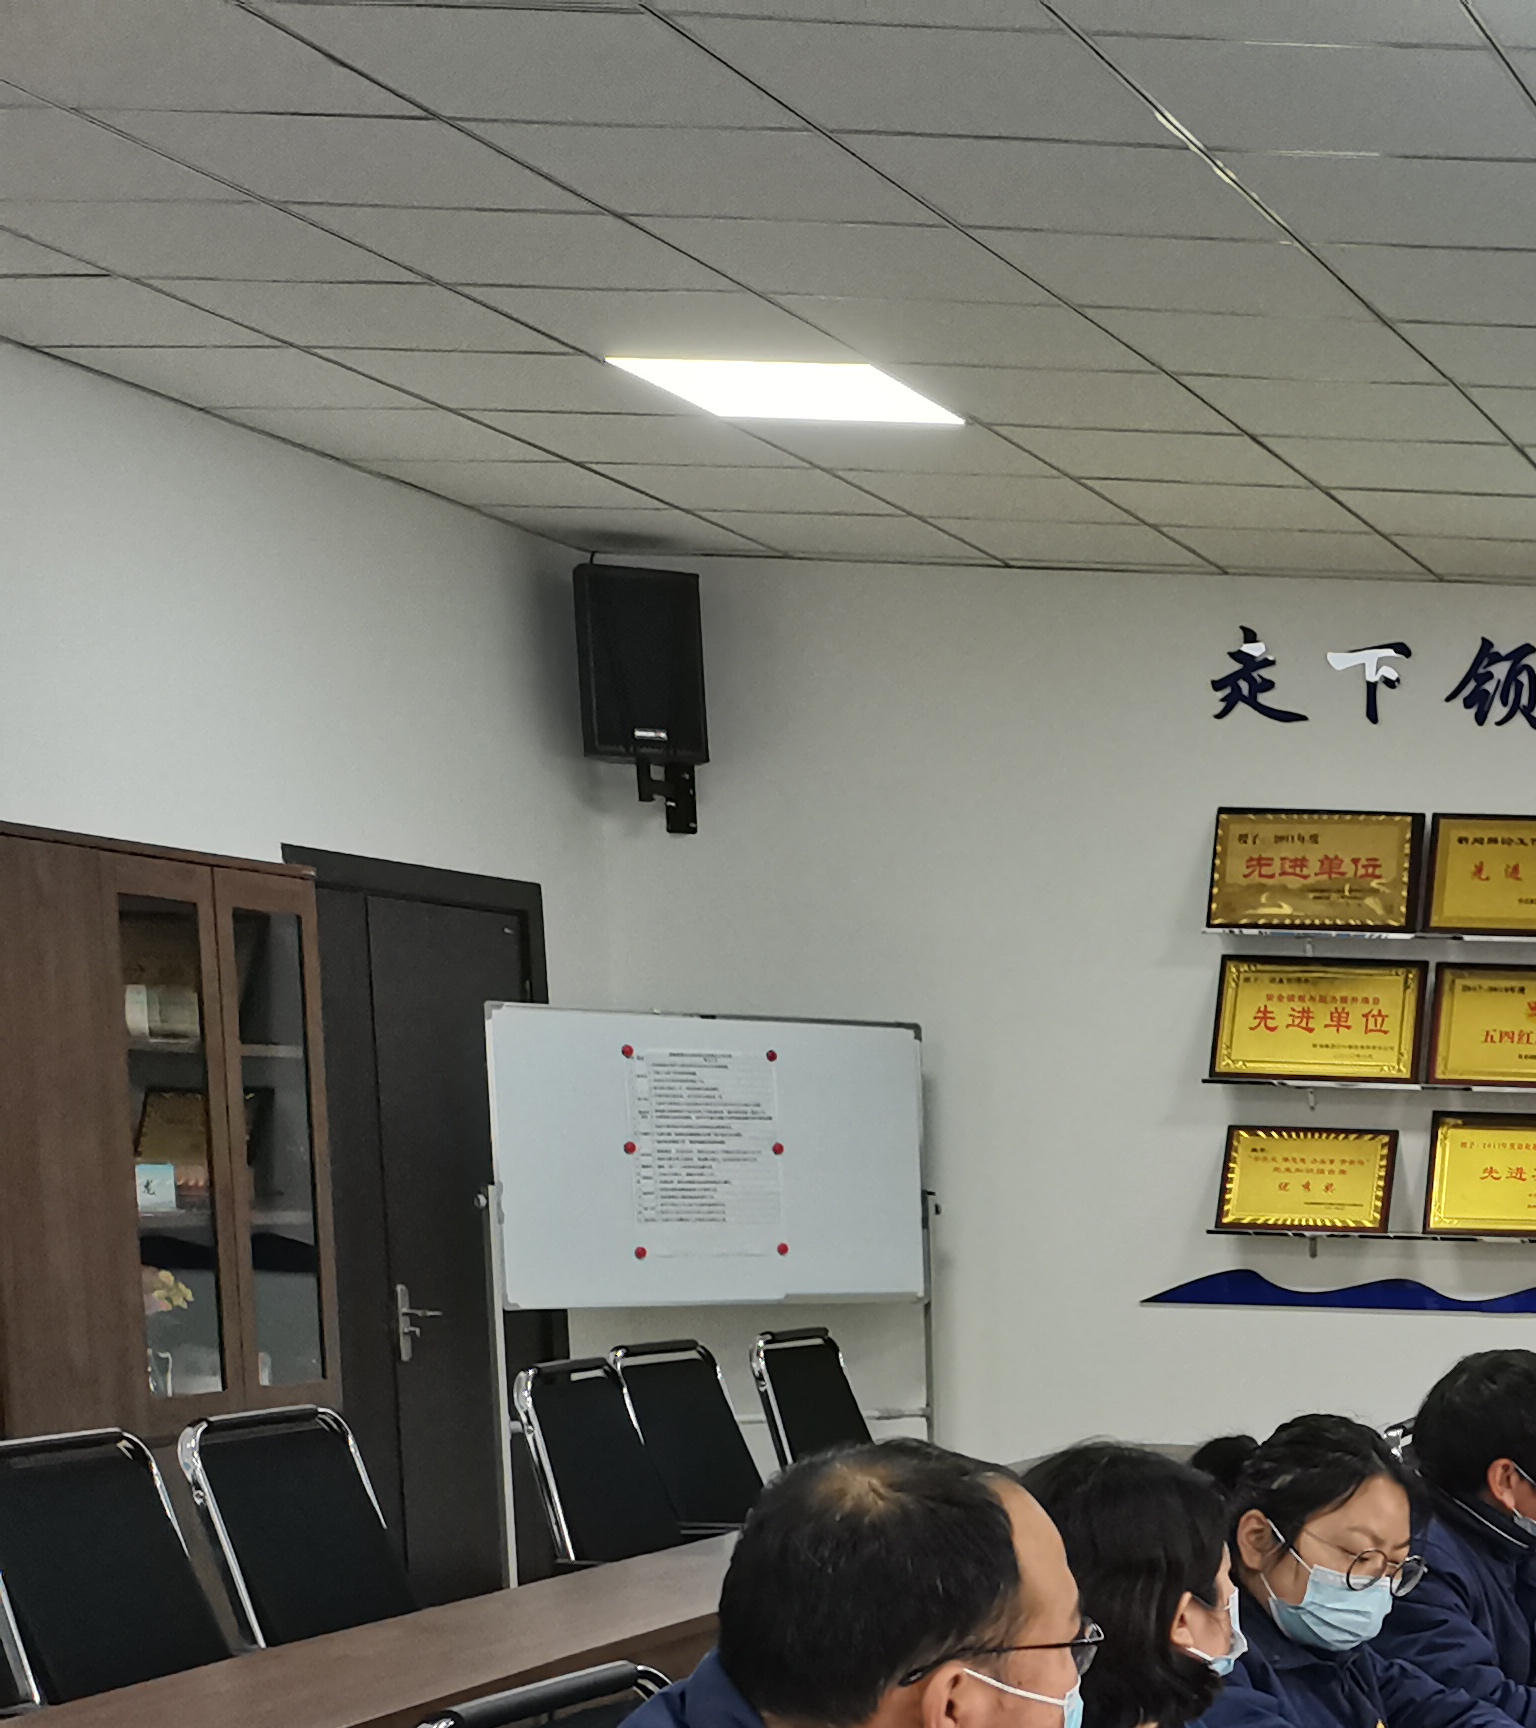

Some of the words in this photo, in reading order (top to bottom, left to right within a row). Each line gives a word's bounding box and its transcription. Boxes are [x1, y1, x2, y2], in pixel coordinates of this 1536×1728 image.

[1242, 854, 1384, 880] 先进单位
[1249, 1004, 1390, 1035] 先进单位
